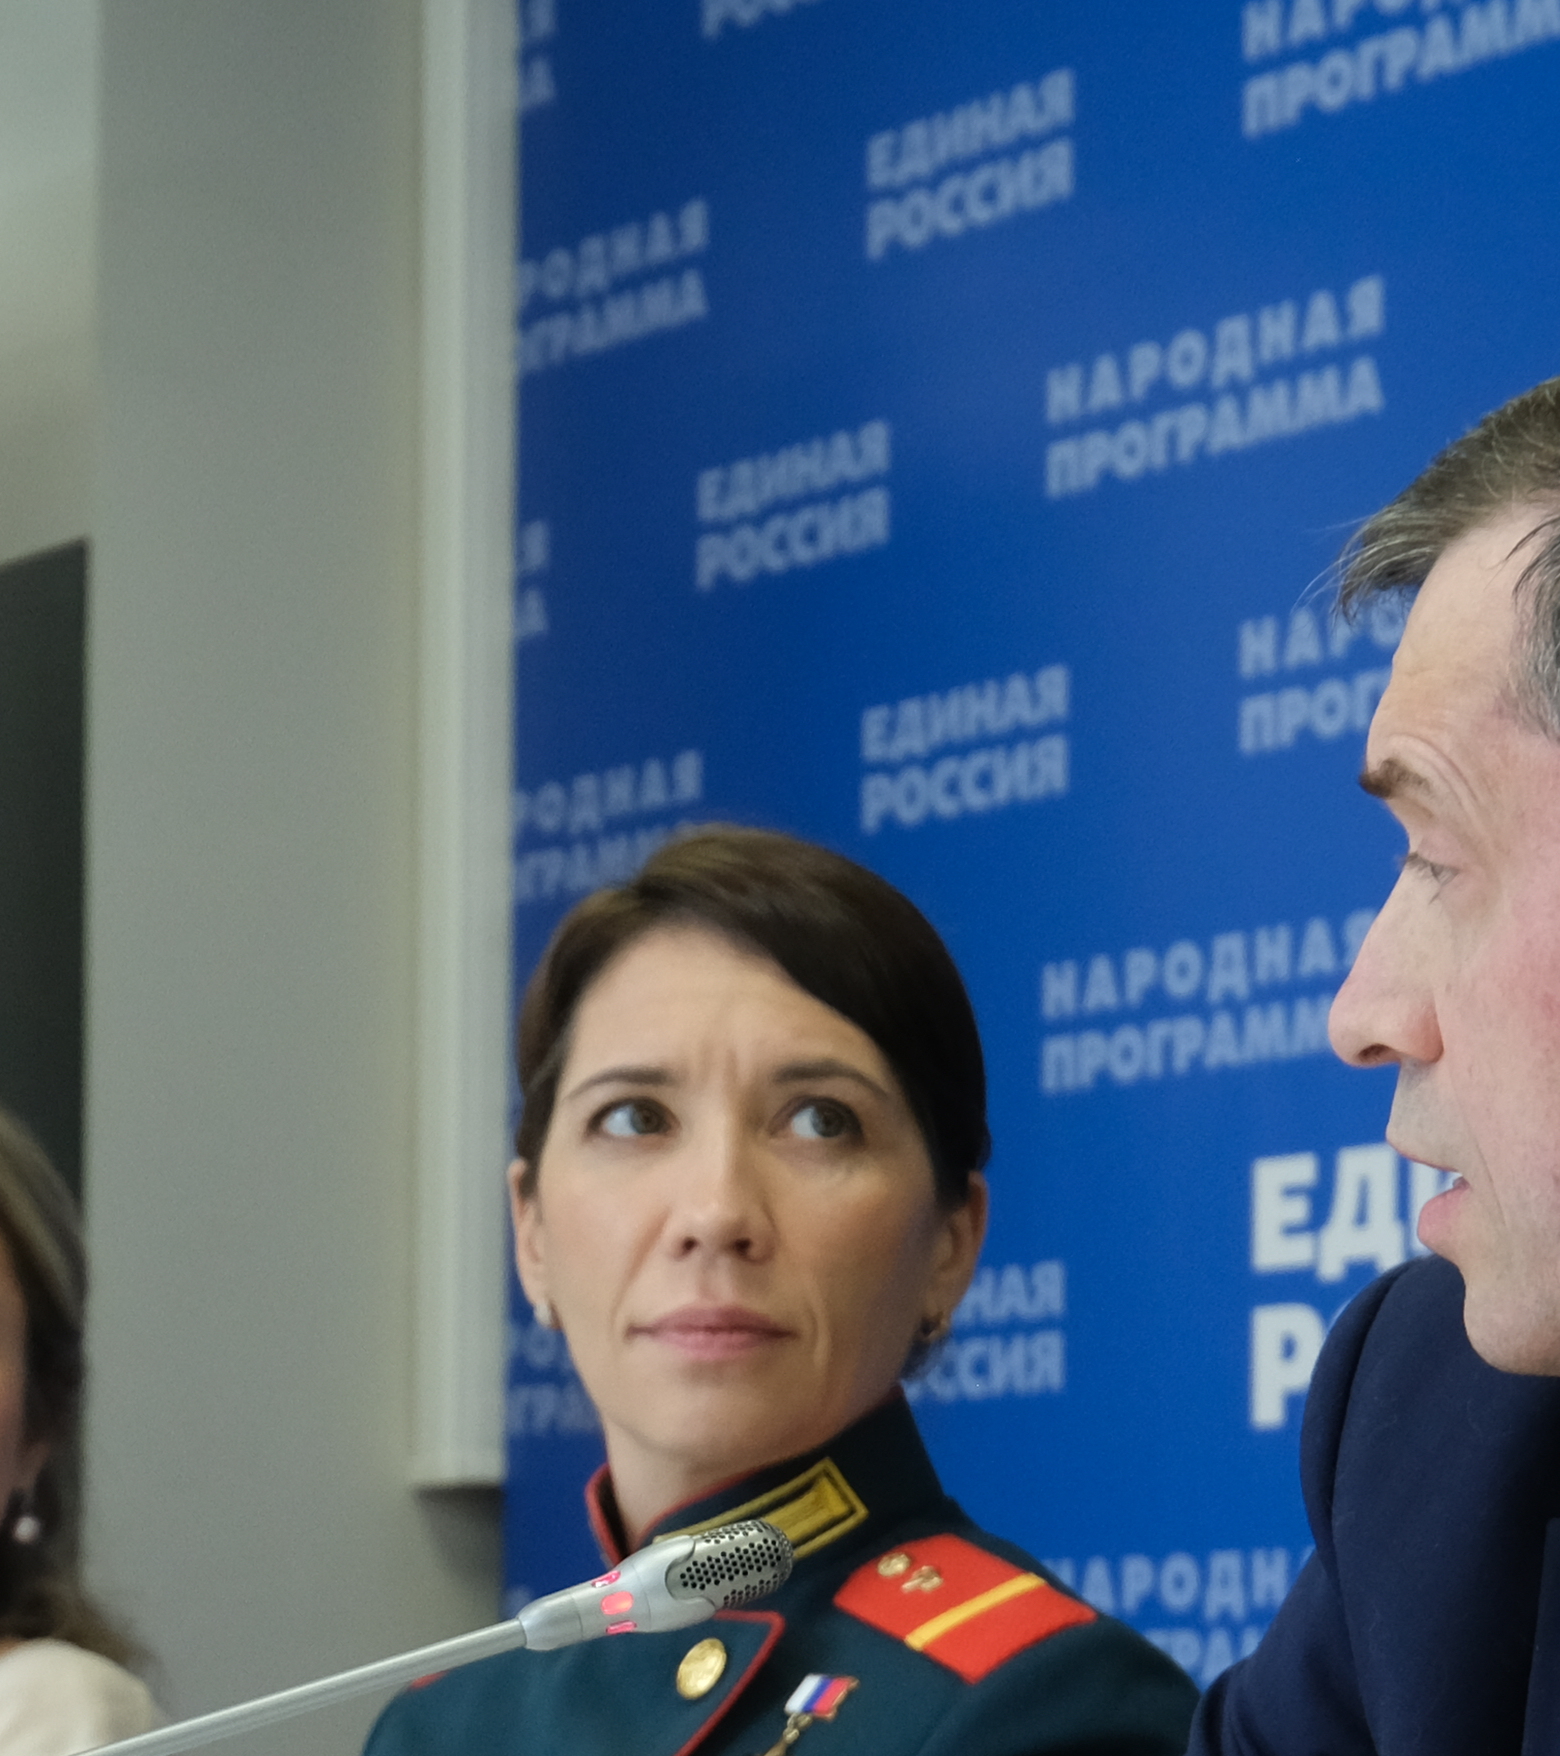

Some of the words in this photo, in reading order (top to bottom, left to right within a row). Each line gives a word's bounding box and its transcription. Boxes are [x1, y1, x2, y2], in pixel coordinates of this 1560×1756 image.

[866, 70, 1074, 190] ЕДИНАЯ
[866, 138, 1074, 261] РОССИЯ
[1045, 276, 1387, 428] НАРОДНАЯ
[698, 421, 892, 526] ЕДИНАЯ
[1045, 356, 1387, 501] ПРОГРАММА
[698, 486, 892, 593] РОССИЯ
[862, 665, 1070, 765] ЕДИНАЯ
[862, 736, 1070, 834] РОССИЯ
